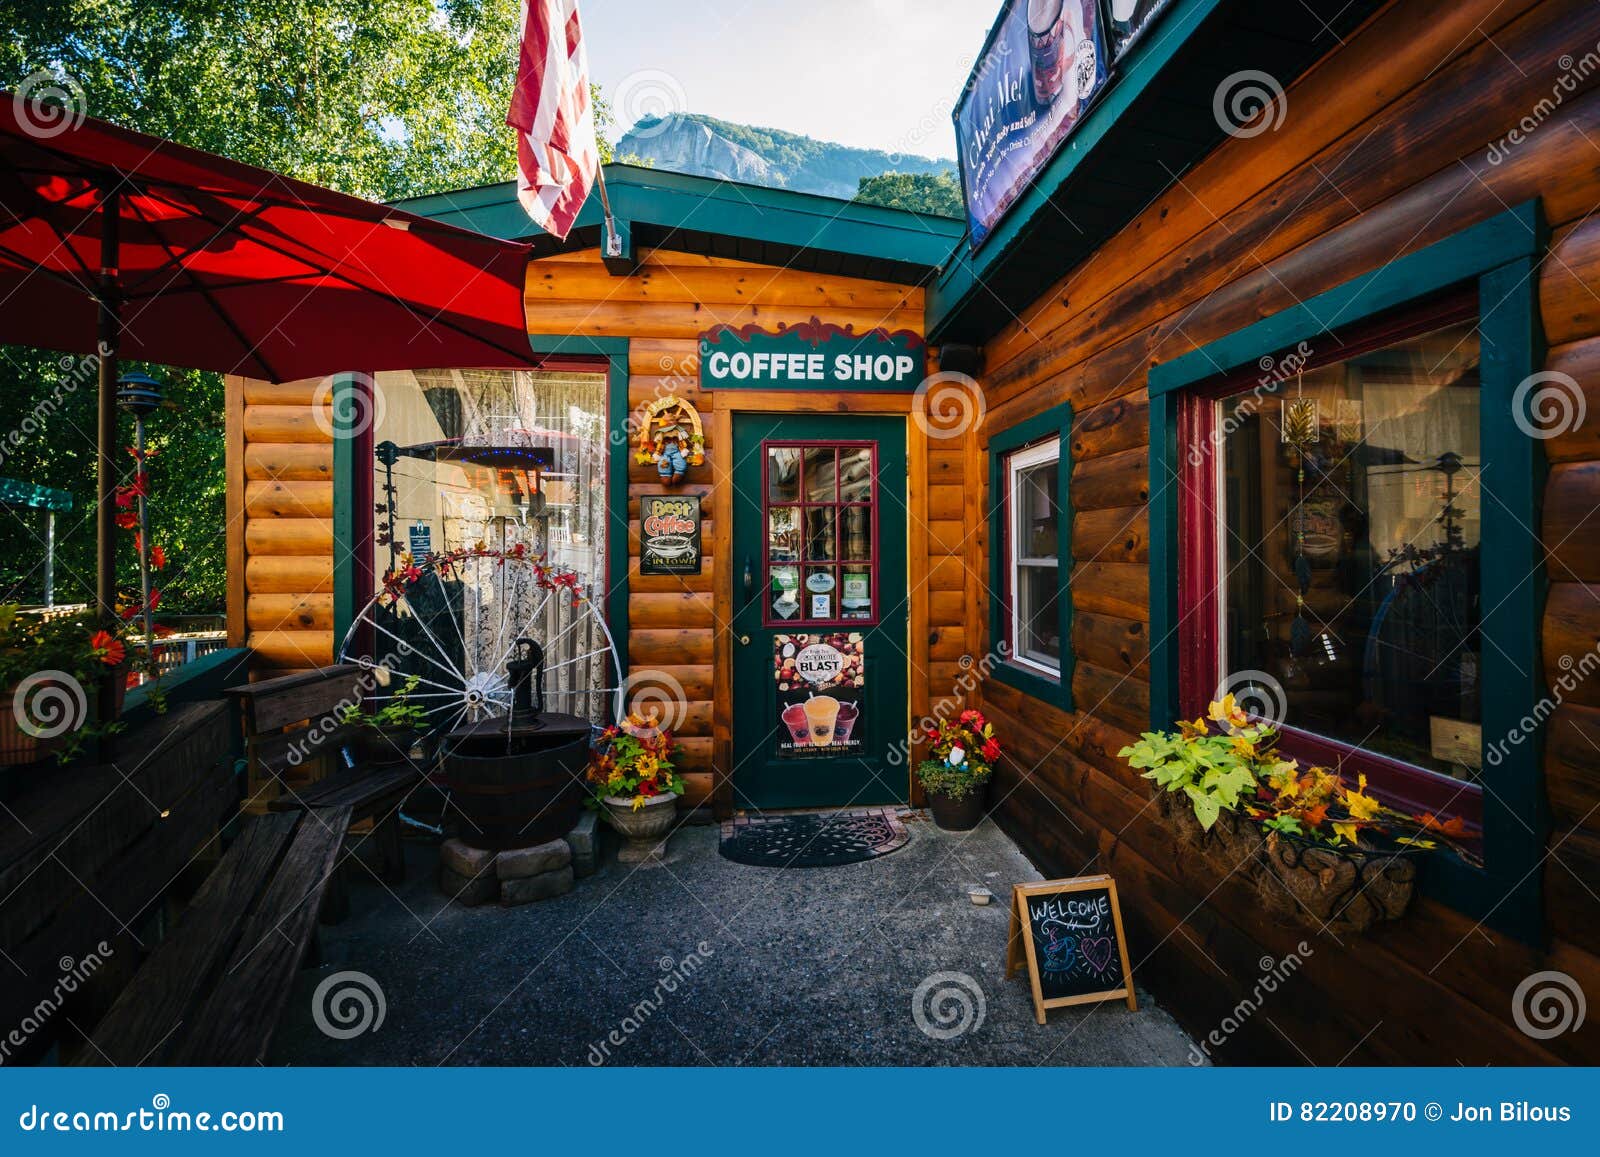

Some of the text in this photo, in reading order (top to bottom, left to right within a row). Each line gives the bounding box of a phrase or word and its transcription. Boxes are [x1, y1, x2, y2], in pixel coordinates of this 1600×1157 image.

[969, 97, 995, 169] Chai
[997, 66, 1023, 113] Me!
[709, 351, 914, 382] COFFEE SHOP
[451, 467, 537, 495] OPEN
[652, 500, 691, 518] Best
[644, 515, 695, 537] Coffee
[800, 661, 839, 671] BLAST
[1030, 896, 1110, 921] WELCOME
